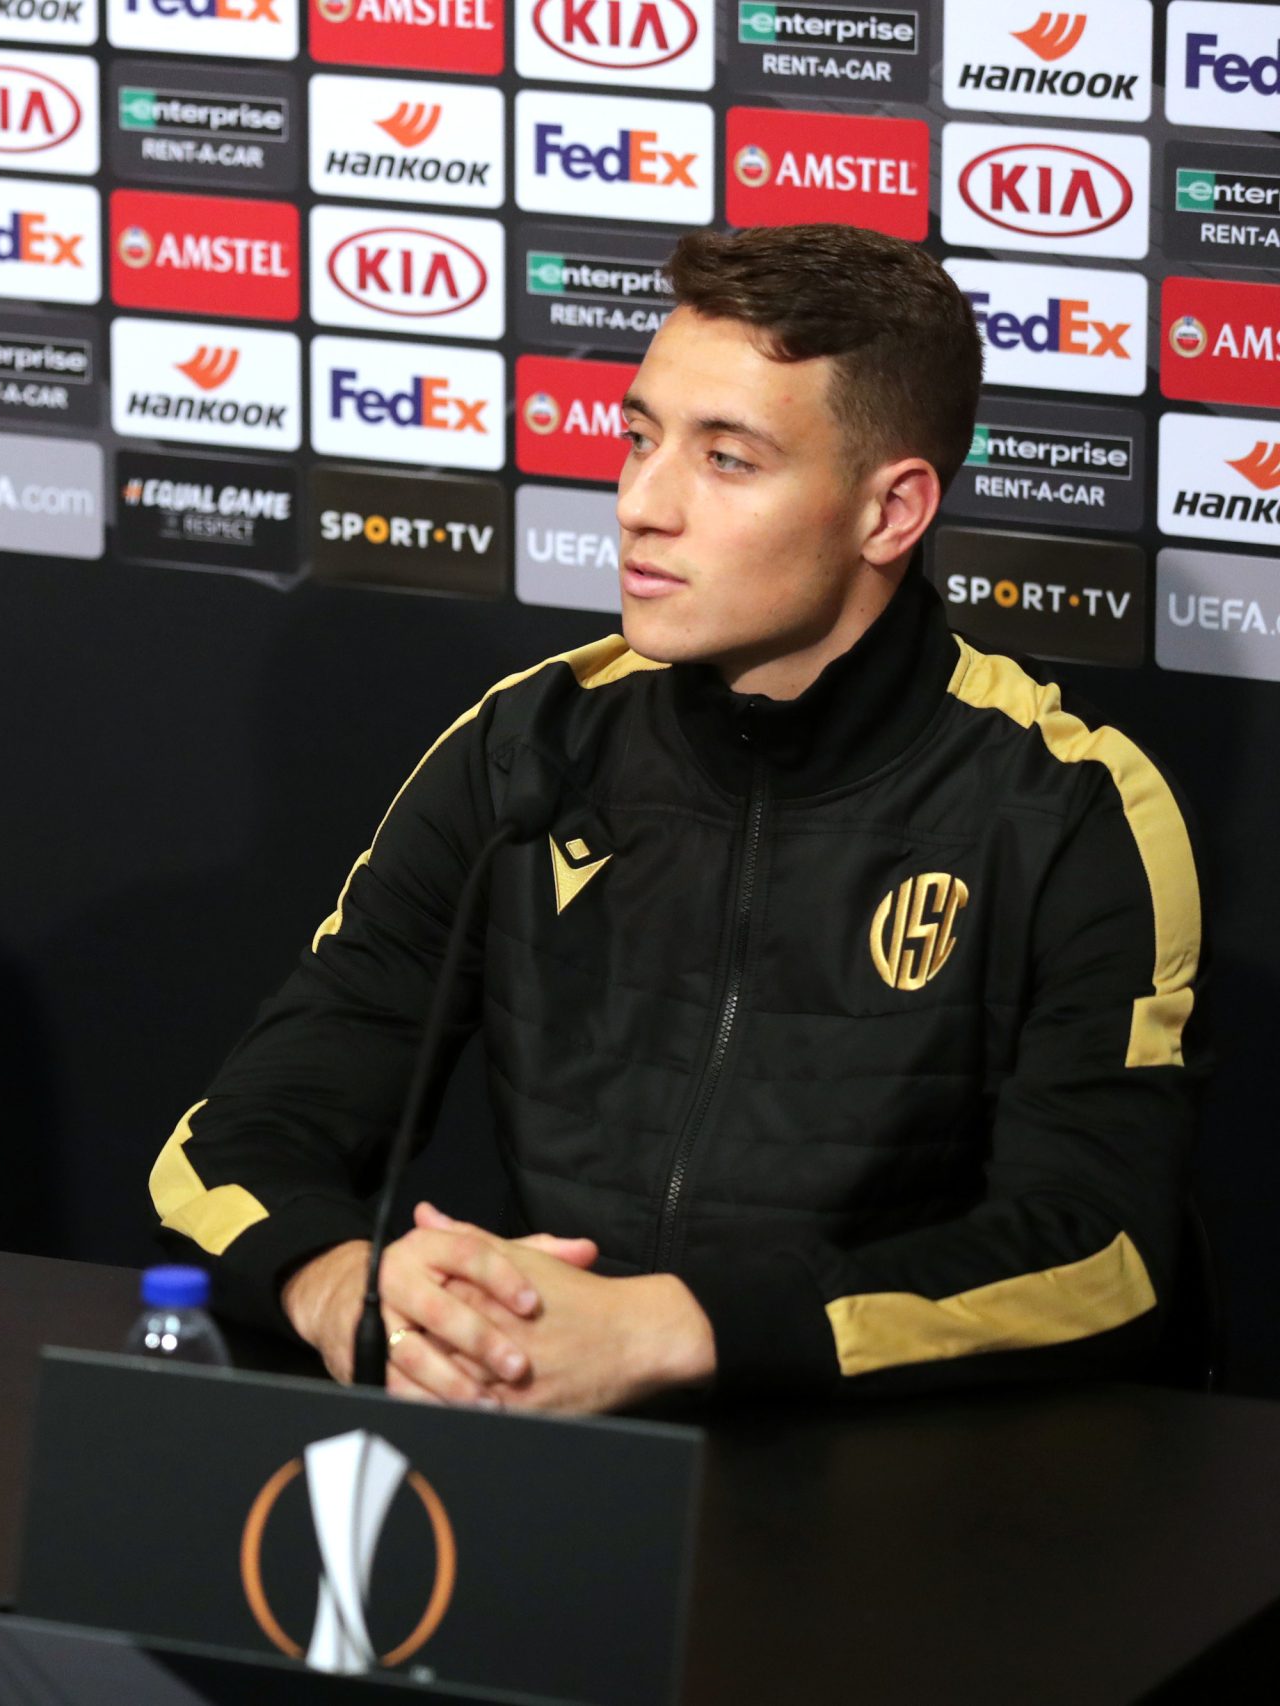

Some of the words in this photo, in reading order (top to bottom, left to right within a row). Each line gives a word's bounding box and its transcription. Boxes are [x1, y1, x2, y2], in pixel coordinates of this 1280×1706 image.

[356, 0, 495, 30] AMSTEL
[562, 0, 669, 50] KIA
[750, 12, 914, 43] enterprise
[762, 53, 892, 82] RENT-A-CAR
[133, 98, 284, 131] enterprise
[141, 137, 264, 168] RENT-A-CAR
[534, 122, 699, 189] FedEx
[775, 150, 918, 197] AMSTEL
[989, 162, 1103, 219] KIA
[1187, 180, 1280, 211] enter
[156, 233, 290, 278] AMSTEL
[355, 245, 459, 299] KIA
[538, 264, 675, 296] enterpris
[1212, 322, 1280, 362] AM
[330, 368, 489, 434] FedEx
[969, 434, 1129, 467] enterprise
[975, 475, 1105, 507] RENT-A-CAR
[1173, 490, 1280, 525] Hank
[526, 528, 620, 568] UEFA
